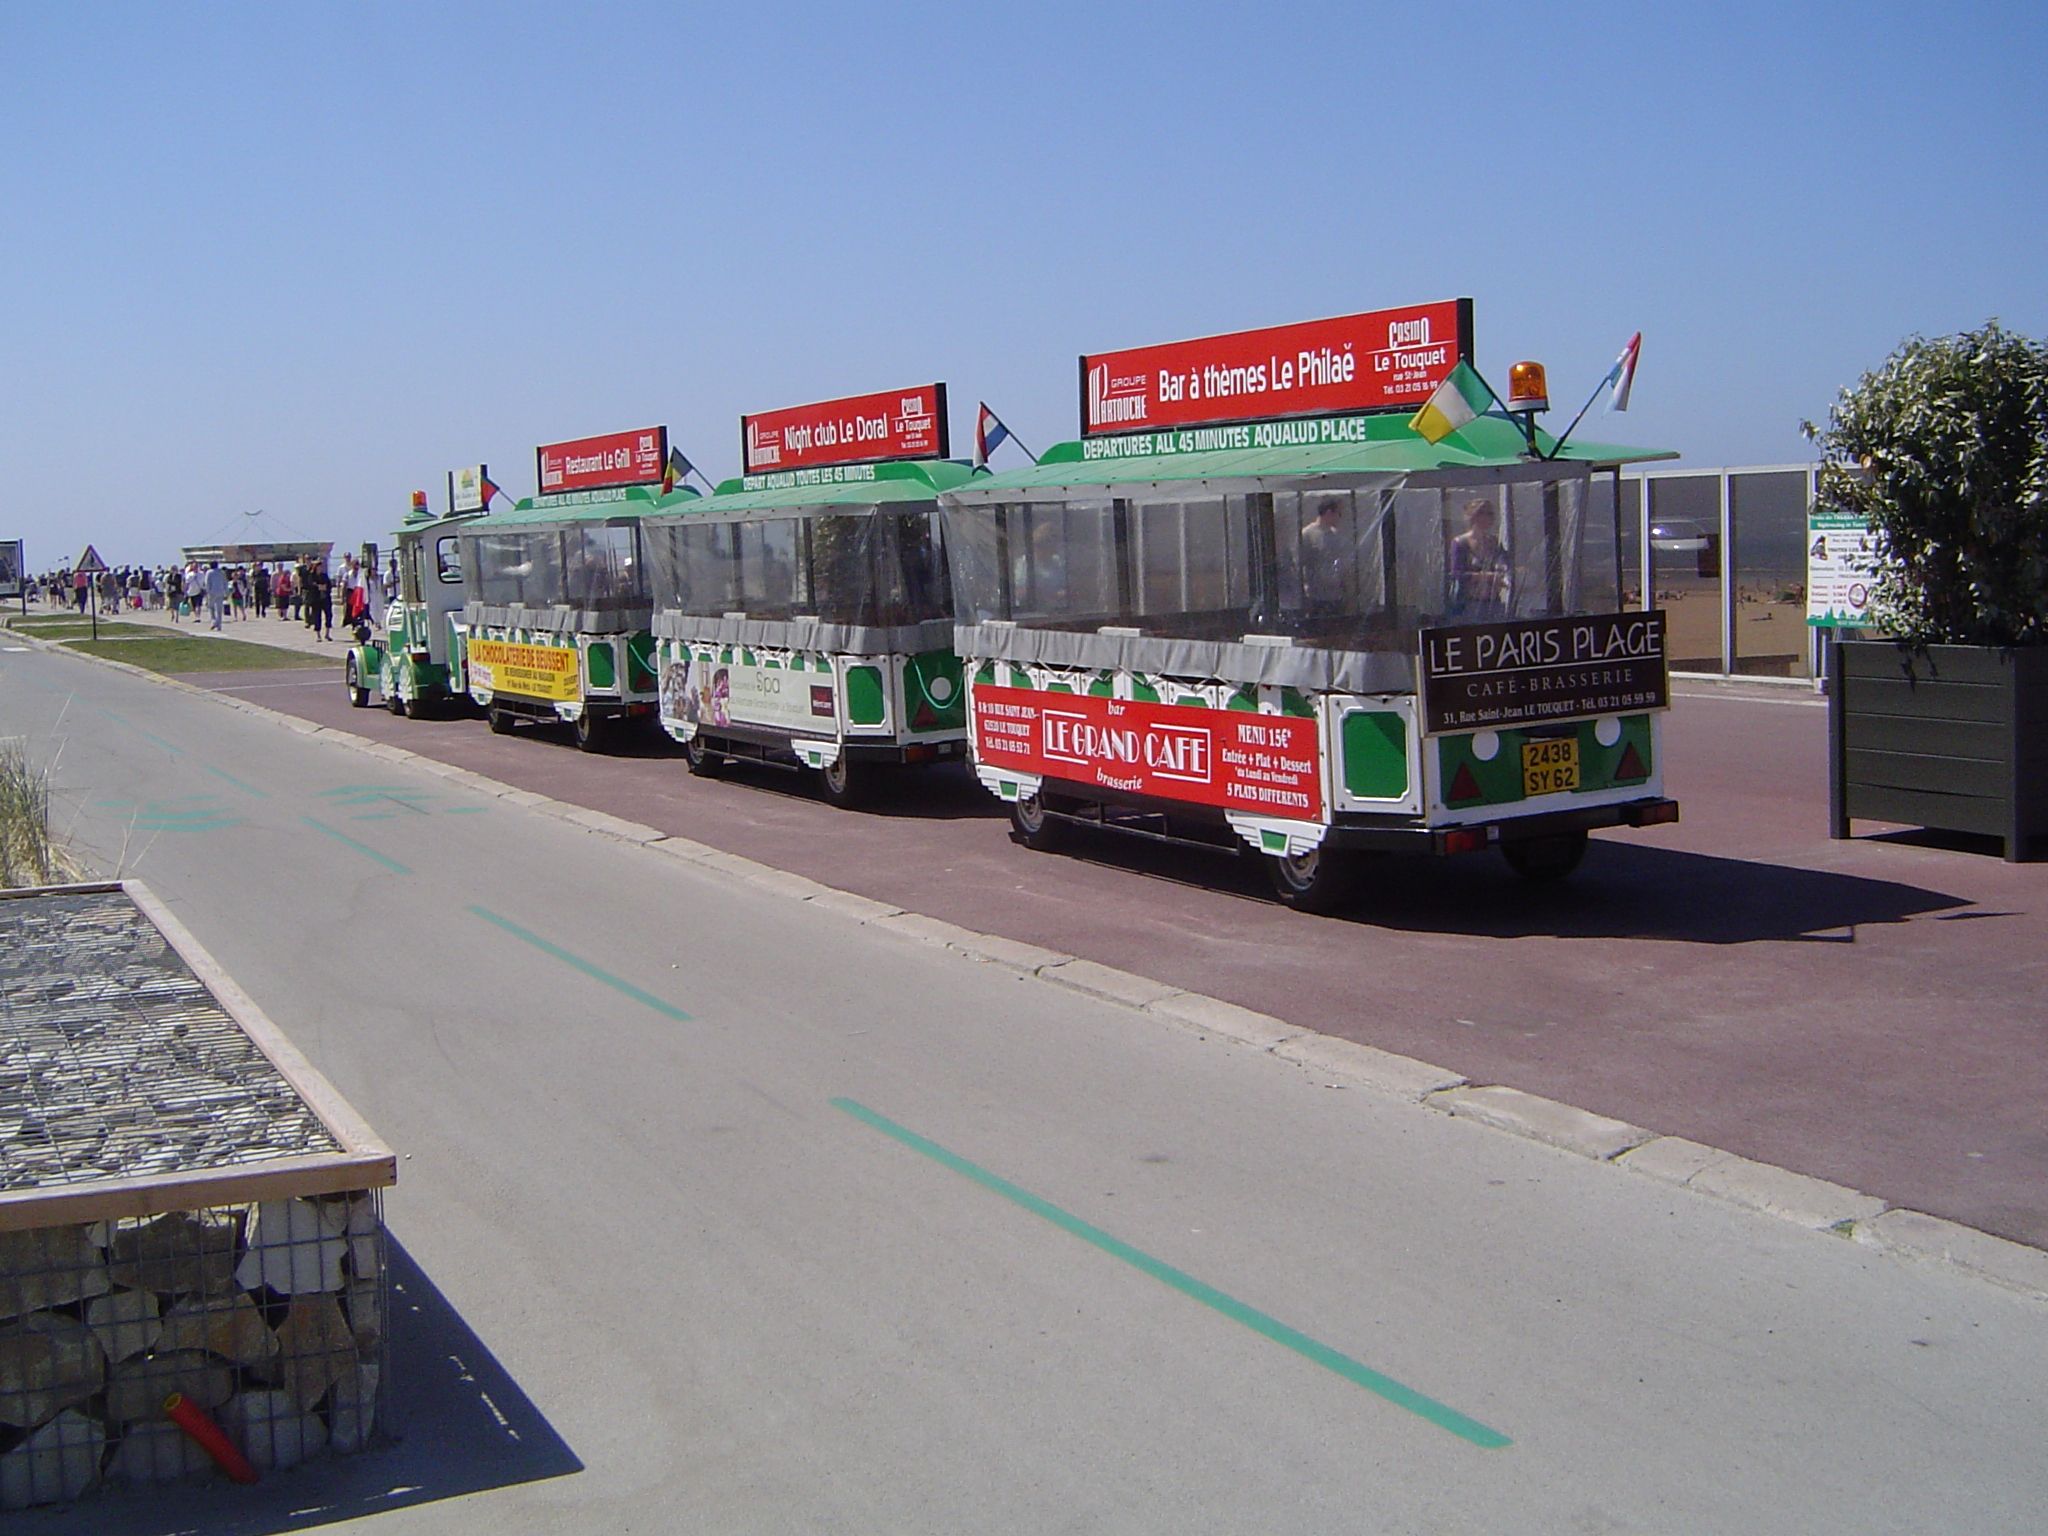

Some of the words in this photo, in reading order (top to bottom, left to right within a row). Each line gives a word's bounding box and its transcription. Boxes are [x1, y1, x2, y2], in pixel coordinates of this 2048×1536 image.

[1374, 355, 1390, 372] Le
[1393, 346, 1446, 370] Touquet
[1111, 375, 1146, 388] GROUPE
[1159, 369, 1186, 402] Bar
[1189, 367, 1200, 400] à
[1204, 363, 1266, 398] thèmes
[1271, 355, 1293, 391] Le
[1089, 363, 1147, 425] PARTOUCHE
[784, 425, 813, 457] Night
[814, 420, 838, 447] club
[839, 419, 854, 443] Le
[856, 412, 889, 441] Doral
[894, 420, 904, 433] Le
[904, 417, 931, 433] Touquet
[1083, 437, 1153, 460] DEPARTURES
[1156, 435, 1176, 454] ALL
[1178, 434, 1194, 452] 45
[1195, 426, 1250, 450] MINUTES
[1253, 422, 1318, 448] AQUALUD
[1321, 418, 1367, 442] PLACE
[565, 454, 603, 475] Restaurant
[603, 451, 614, 471] Le
[615, 448, 630, 469] Grill
[821, 467, 834, 483] LES
[1429, 637, 1463, 673] LE
[1476, 628, 1561, 669] PARIS
[1572, 620, 1661, 660] PLAGE
[756, 671, 780, 697] Spa
[1107, 700, 1125, 716] bar
[1443, 711, 1458, 724] 31,
[1459, 710, 1476, 723] Rue
[1477, 706, 1523, 721] Saint-Jean
[1524, 704, 1536, 715] LE
[1537, 699, 1575, 714] TOUQUET
[1597, 697, 1608, 708] 03
[1610, 696, 1620, 707] 21
[1045, 719, 1070, 752] LE
[1072, 723, 1140, 764] GRAND
[1143, 732, 1207, 774] CAFE
[1237, 723, 1266, 746] MENU
[1222, 748, 1246, 765] Entrée
[1255, 752, 1271, 768] Plat
[1280, 756, 1312, 774] Dessert
[1529, 742, 1572, 767] 2438
[1096, 767, 1143, 791] brasserie
[1245, 767, 1262, 780] Lundi
[1271, 771, 1298, 786] Vendredi
[1529, 770, 1550, 792] SY
[1553, 767, 1575, 787] 62
[1226, 782, 1233, 797] 5
[1233, 783, 1257, 800] PLATS
[1258, 787, 1309, 808] DIFFERENTS
